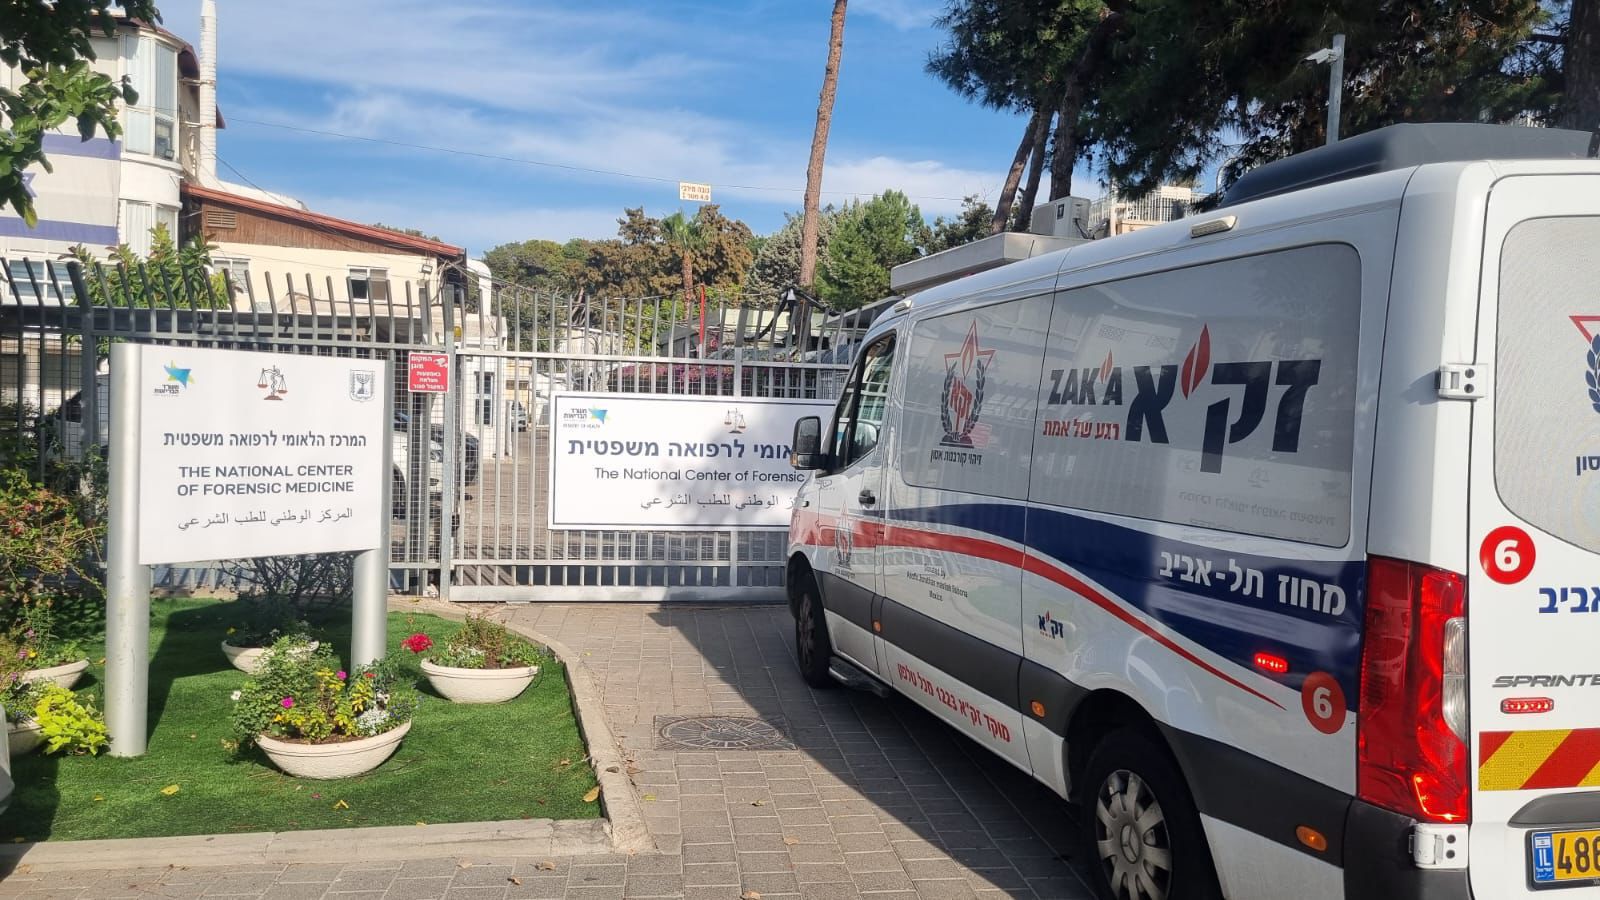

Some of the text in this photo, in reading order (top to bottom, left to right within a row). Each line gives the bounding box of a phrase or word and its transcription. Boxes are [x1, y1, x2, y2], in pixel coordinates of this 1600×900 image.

[163, 430, 367, 447] המרכז הלאומי לרפואה משפטית
[1042, 418, 1119, 440] רגע של אמת
[567, 438, 660, 457] משפטית
[668, 439, 745, 459] לרפואה
[930, 449, 943, 463] אסון
[178, 464, 354, 478] THE NATIONAL CENTER
[594, 467, 806, 484] The National Center of Forensic
[177, 481, 354, 497] OF FORENSIC MEDICINE
[640, 493, 692, 510] الشرعي
[697, 494, 731, 506] للطب
[735, 495, 779, 510] الوطني
[178, 507, 353, 531] المركز الوطني للطب الشرعي
[1494, 539, 1521, 572] 6
[1159, 551, 1347, 617] מחוז תל-אביב
[917, 671, 935, 697] מכל
[936, 686, 958, 712] 1223
[1312, 686, 1333, 720] 6
[959, 699, 983, 727] זק"א
[984, 713, 1011, 743] מוקד
[1539, 848, 1552, 867] IL
